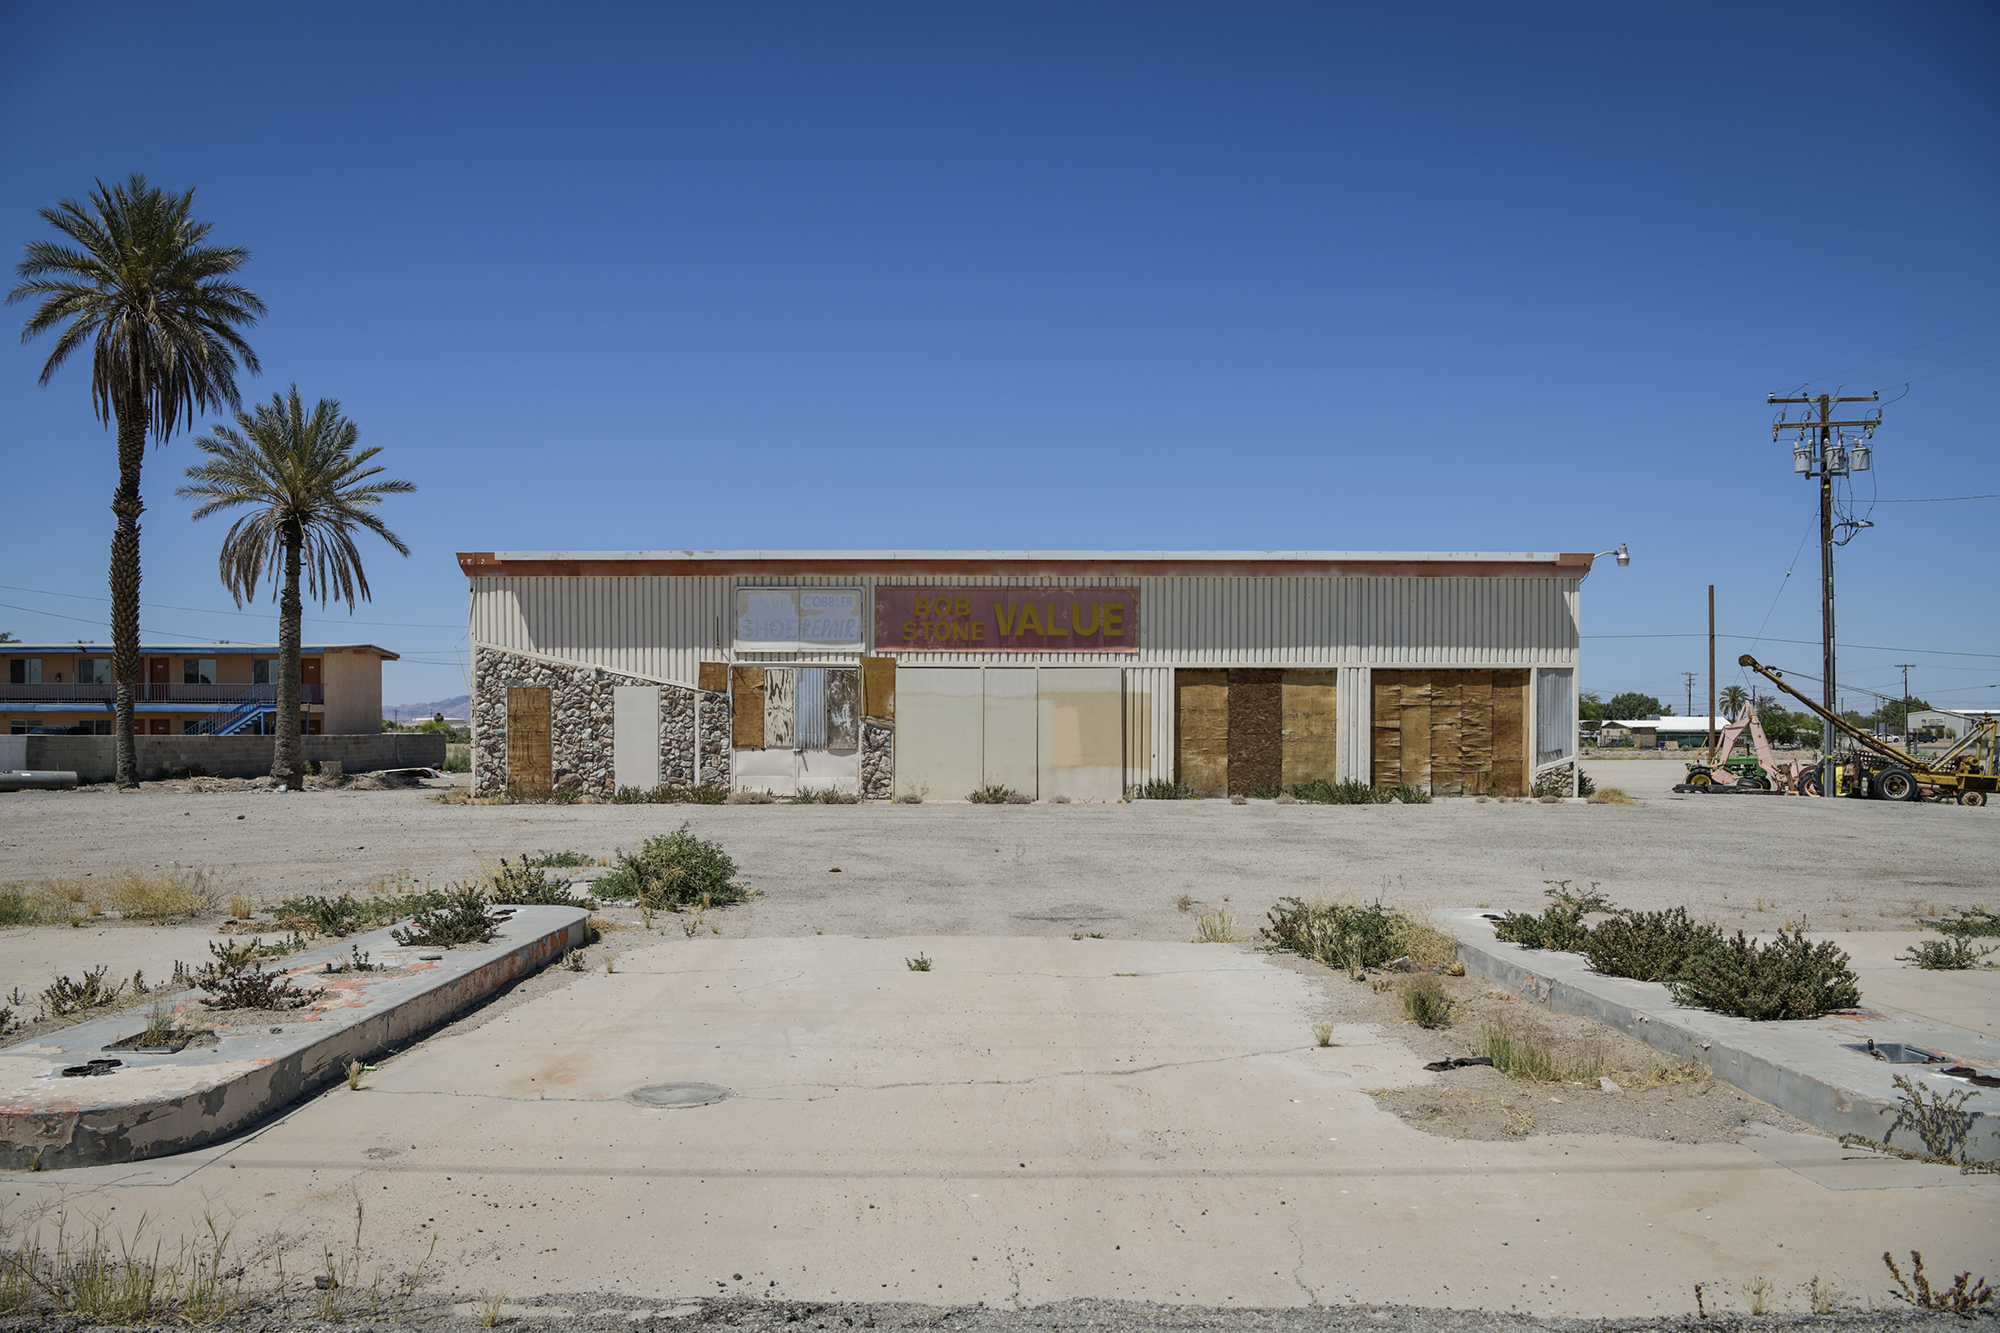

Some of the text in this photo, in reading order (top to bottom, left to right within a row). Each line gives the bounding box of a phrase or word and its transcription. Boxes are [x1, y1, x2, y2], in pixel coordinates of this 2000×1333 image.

[750, 596, 854, 608] VALUE COBBLER
[914, 597, 971, 616] BOB
[740, 618, 856, 639] SHOE REPAIR
[994, 602, 1125, 636] VALUE
[902, 621, 985, 641] STONE
